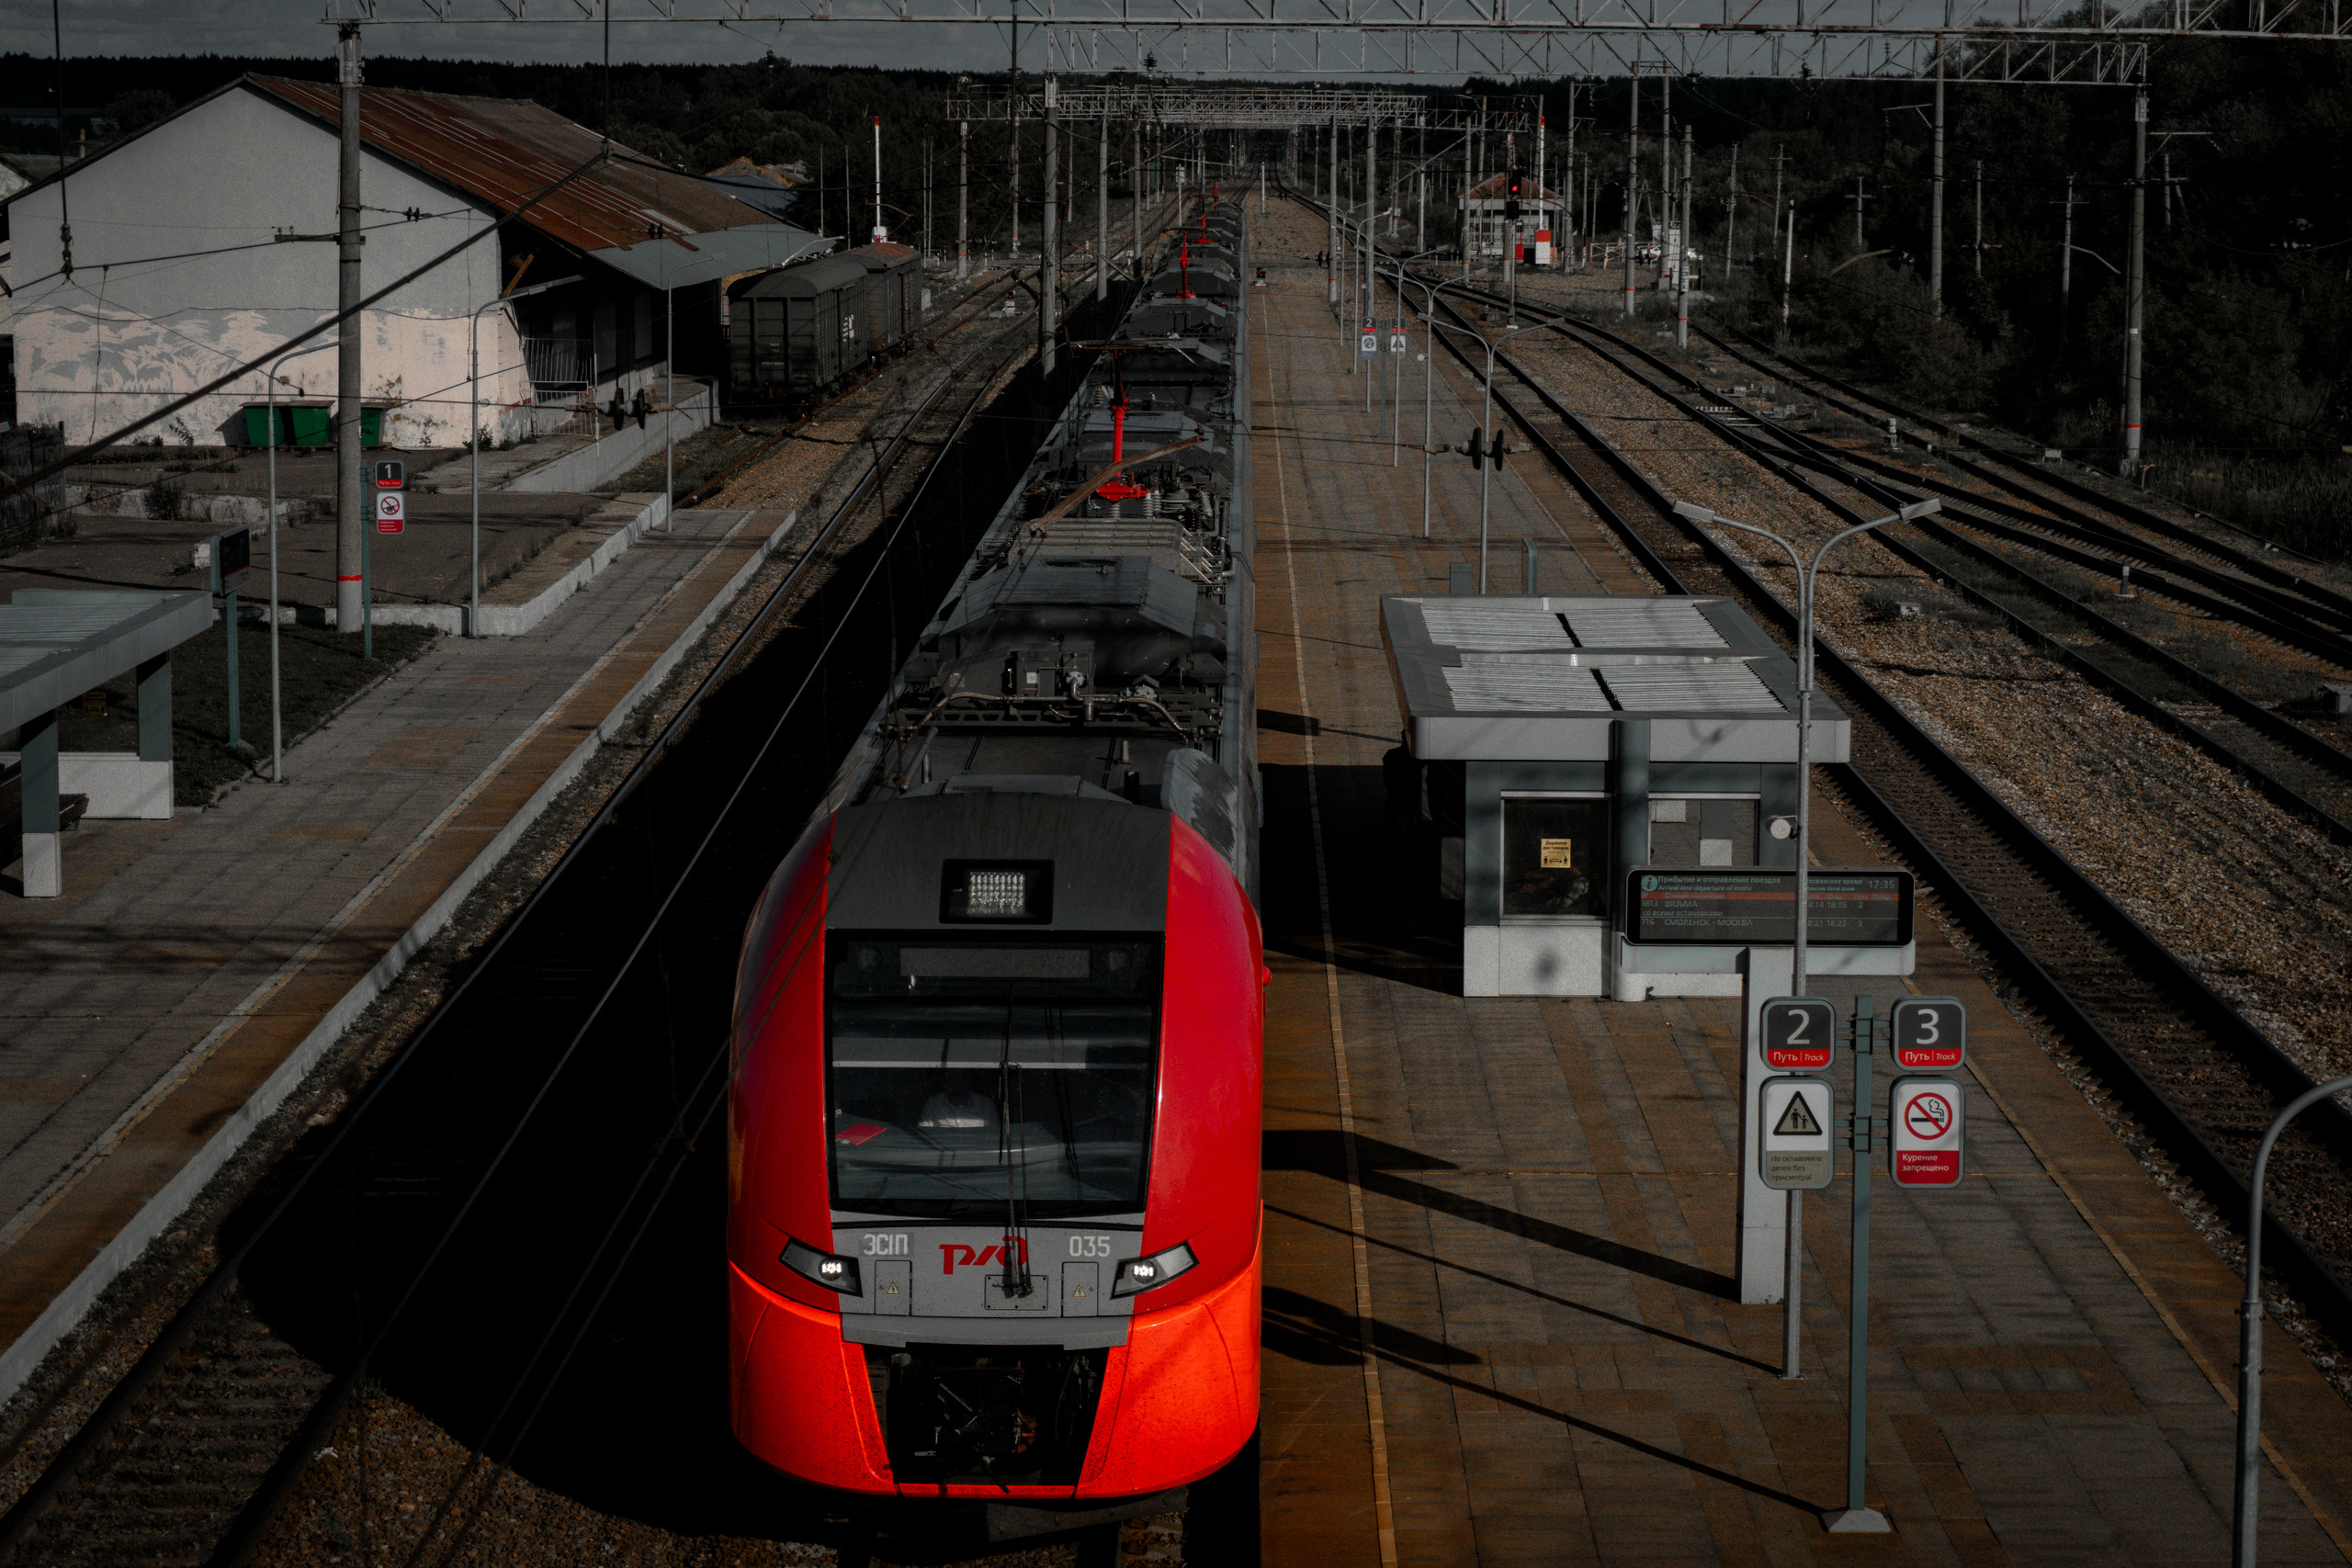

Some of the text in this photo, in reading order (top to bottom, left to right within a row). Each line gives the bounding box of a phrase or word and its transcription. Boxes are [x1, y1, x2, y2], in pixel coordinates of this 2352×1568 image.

[1366, 318, 1373, 327] 2
[384, 464, 391, 479] 1
[1868, 880, 1894, 889] 17:35
[1786, 1009, 1811, 1045] 2
[1916, 1008, 1939, 1045] 3
[1773, 1051, 1825, 1063] Путь Track
[1905, 1051, 1956, 1063] Путь Track
[1902, 1153, 1939, 1164] Курение
[1770, 1164, 1792, 1173] детей
[1902, 1164, 1950, 1173] запрещено
[1069, 1235, 1110, 1258] 035
